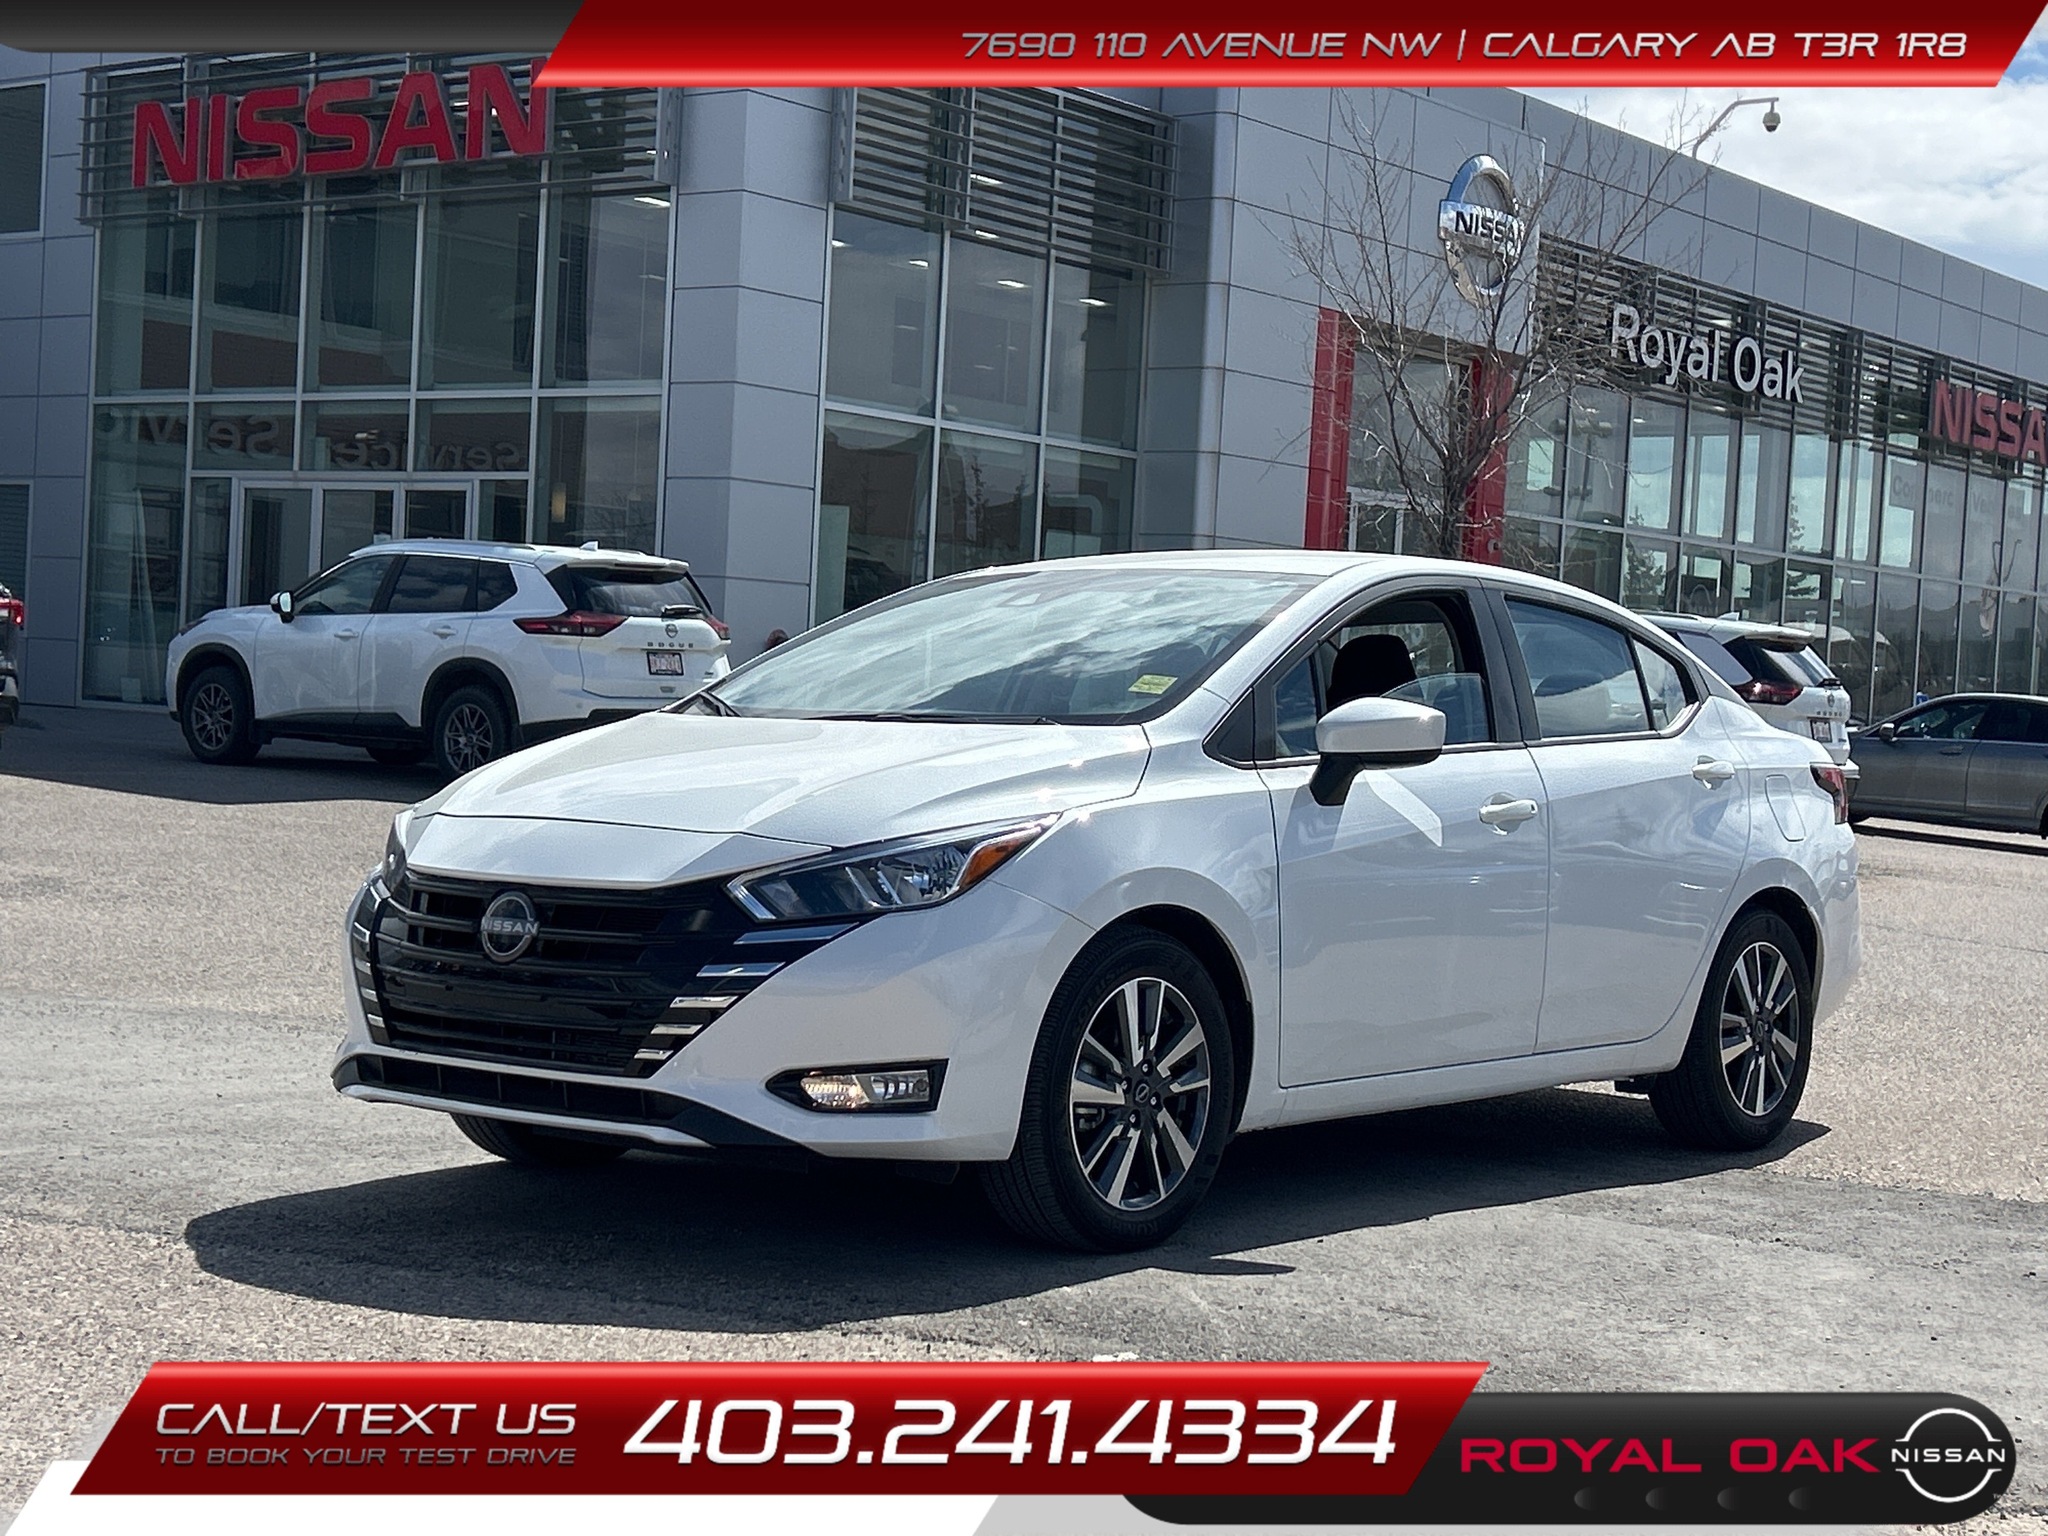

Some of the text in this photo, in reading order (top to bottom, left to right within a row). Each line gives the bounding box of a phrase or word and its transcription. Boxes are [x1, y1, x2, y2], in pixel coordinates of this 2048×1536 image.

[132, 57, 548, 188] NISSAN
[1610, 303, 1805, 404] Royal Oak
[481, 917, 540, 935] NISSAN
